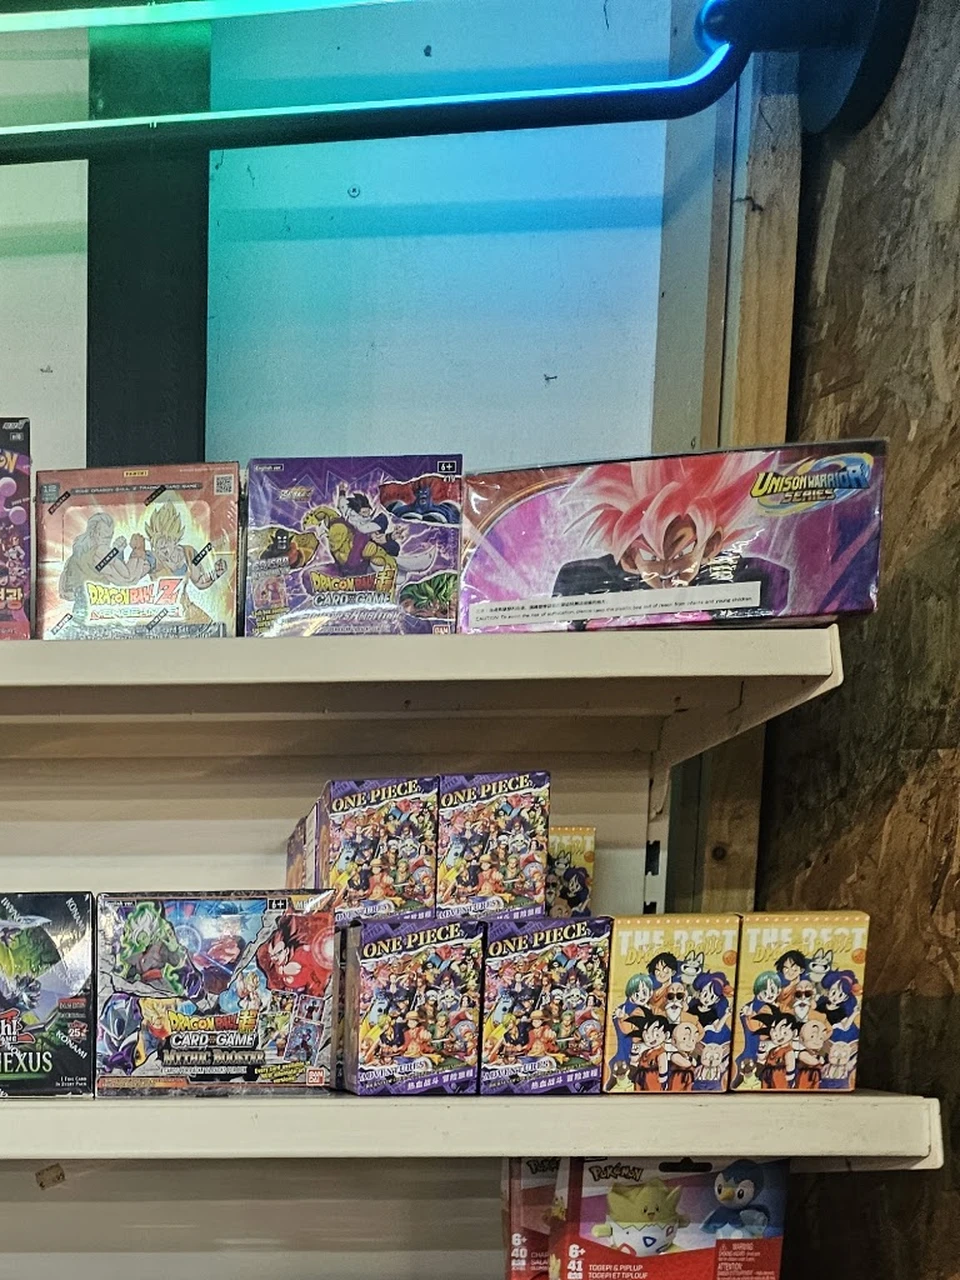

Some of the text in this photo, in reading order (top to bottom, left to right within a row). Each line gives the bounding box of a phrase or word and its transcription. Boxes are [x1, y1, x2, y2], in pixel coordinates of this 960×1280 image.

[750, 472, 807, 498] UNISON
[782, 489, 835, 503] SERIES
[313, 592, 391, 606] CARD GAME
[331, 779, 419, 812] ONE PIECE
[440, 774, 531, 808] ONE PIECE
[271, 900, 285, 909] 6+
[363, 922, 463, 958] ONE PIECE
[489, 921, 589, 957] ONE PIECE
[167, 1010, 215, 1031] DRAGON
[55, 1030, 88, 1060] KONAMI
[171, 1032, 256, 1047] CARD GAME
[163, 1049, 266, 1065] MYTHIC BOOSTER
[511, 1232, 528, 1246] 6+
[510, 1248, 528, 1259] 40
[568, 1244, 586, 1258] 6+
[567, 1260, 583, 1272] 41
